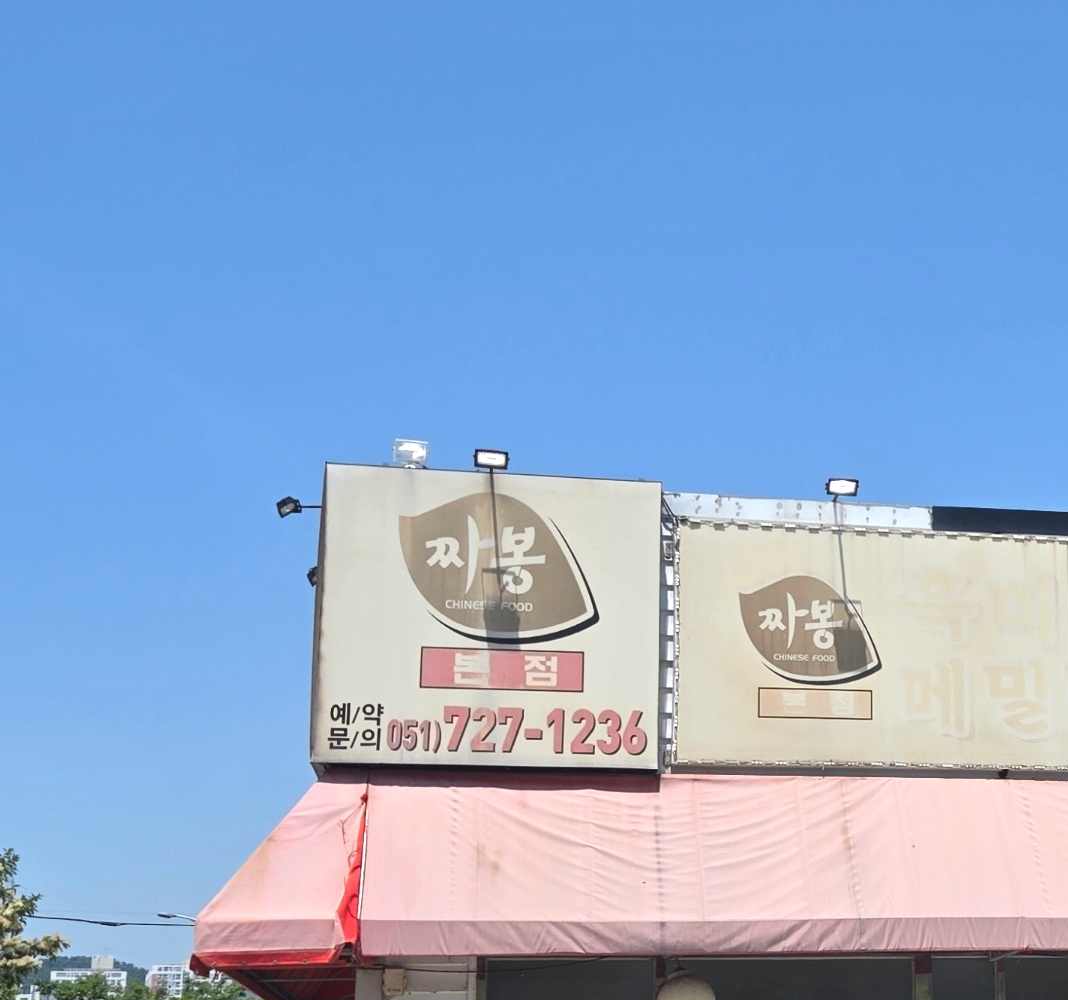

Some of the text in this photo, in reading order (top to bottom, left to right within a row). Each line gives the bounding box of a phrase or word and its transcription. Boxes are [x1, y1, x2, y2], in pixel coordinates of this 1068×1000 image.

[425, 514, 547, 595] 짜봉
[445, 599, 533, 612] CHINESE FOOD
[757, 592, 843, 650] 짜봉
[773, 654, 836, 663] CHINESE FOOD
[330, 702, 384, 724] 예/약
[327, 728, 382, 751] 문/의
